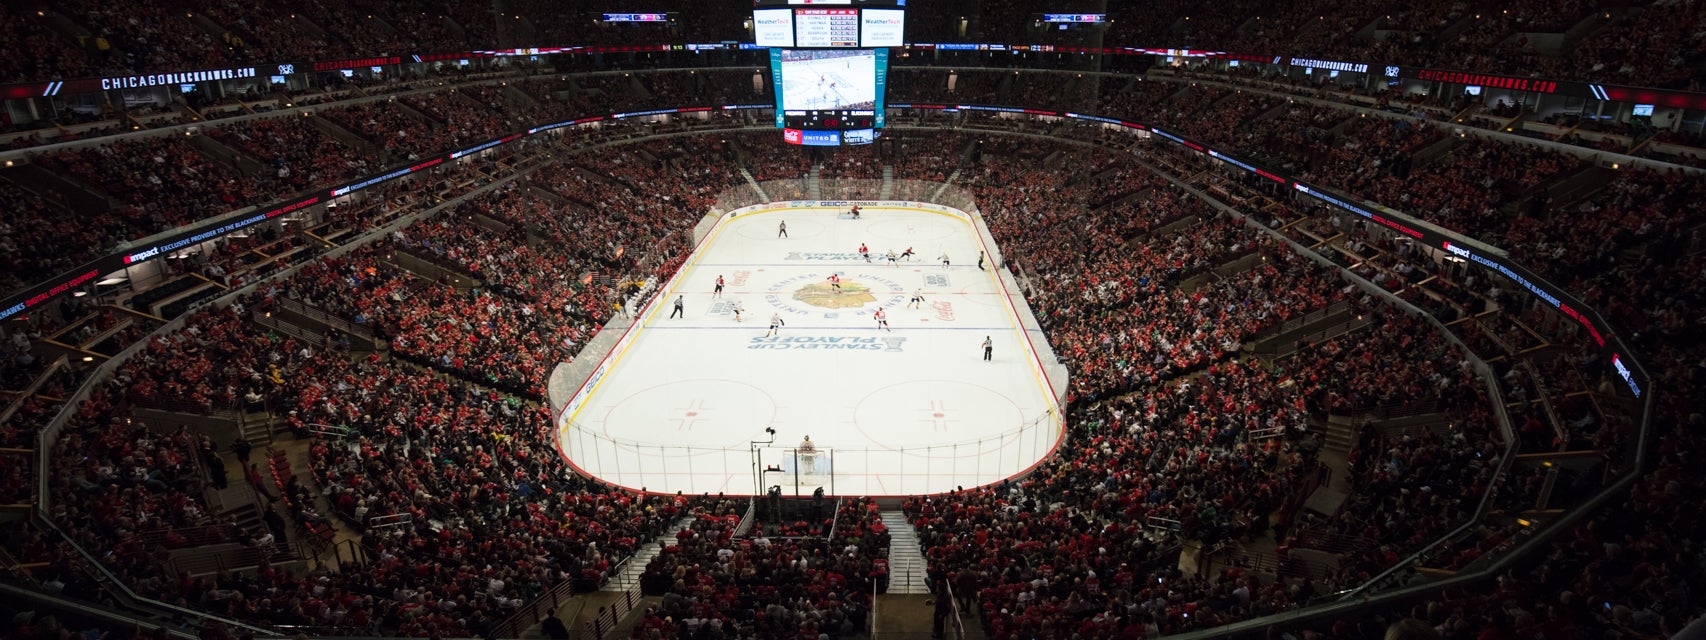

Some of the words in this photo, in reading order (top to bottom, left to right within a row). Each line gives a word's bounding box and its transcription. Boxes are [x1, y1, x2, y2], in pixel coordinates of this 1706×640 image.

[1290, 57, 1368, 73] CHICAGOBLACKHAWKS.COM
[101, 67, 256, 90] CHICAGOBLACKHAWKS.COM
[1418, 69, 1557, 93] CHICAGOBLACKHAWKS.COM
[128, 246, 160, 264] impact
[160, 238, 191, 253] EXCLUSIVE
[190, 230, 217, 243] PROVIDER
[225, 224, 235, 232] THE
[235, 213, 267, 229] BLACKHAWKS
[1446, 241, 1470, 259] impact
[1470, 253, 1499, 270] EXCLUSIVE
[25, 292, 49, 308] DIGITAL
[49, 282, 69, 297] OFFICE
[793, 343, 884, 351] STANLEY
[585, 366, 605, 395] GEICO
